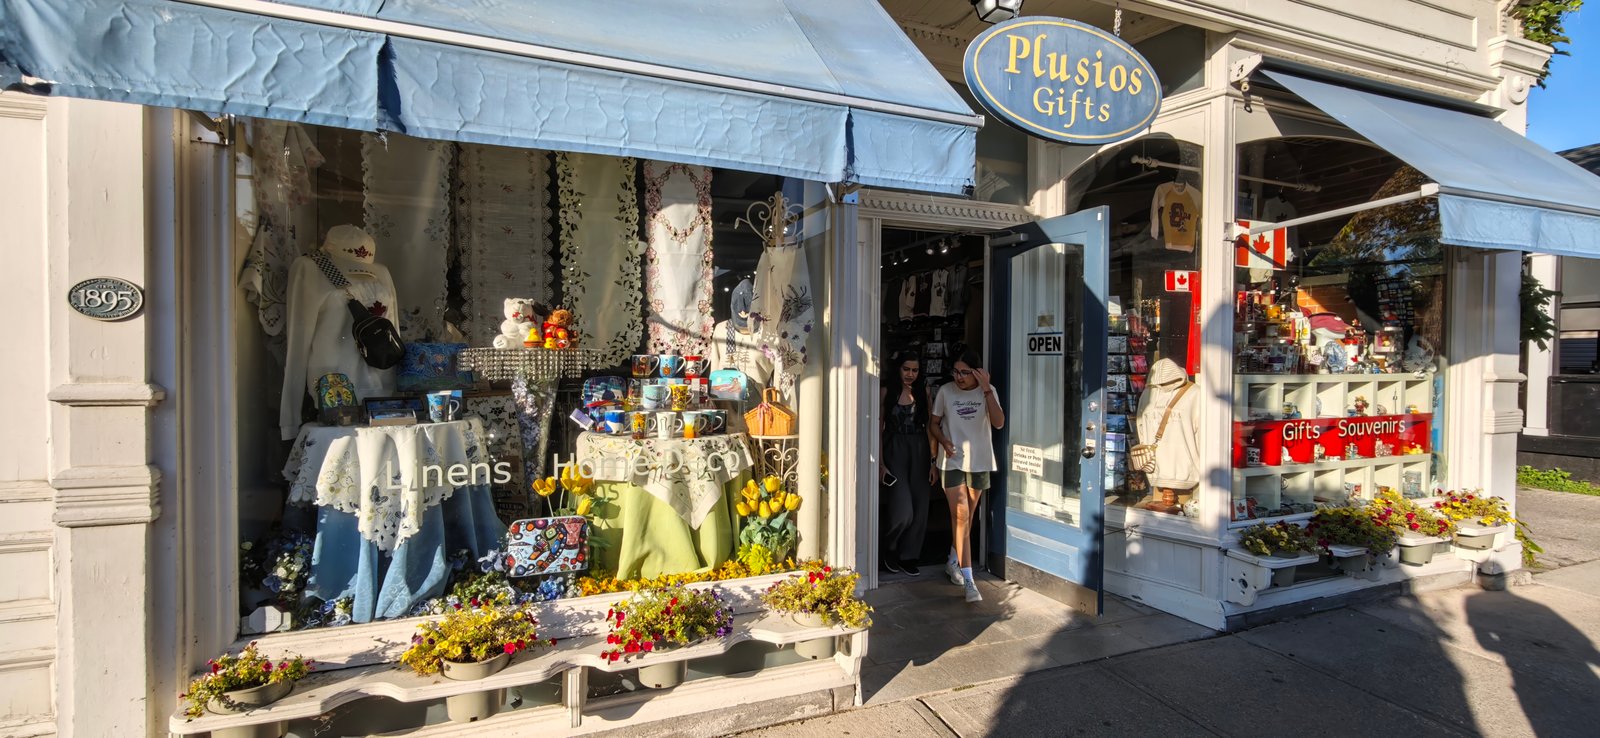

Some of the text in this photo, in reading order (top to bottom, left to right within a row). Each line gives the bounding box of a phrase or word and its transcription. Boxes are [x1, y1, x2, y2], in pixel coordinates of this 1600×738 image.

[1004, 33, 1143, 96] Plusios
[1033, 86, 1111, 128] Gifts
[79, 289, 132, 313] 1895
[1029, 336, 1062, 352] OPEN
[1282, 417, 1406, 441] Gifts Souvenirs
[386, 459, 512, 490] Linens
[553, 452, 650, 481] Home
